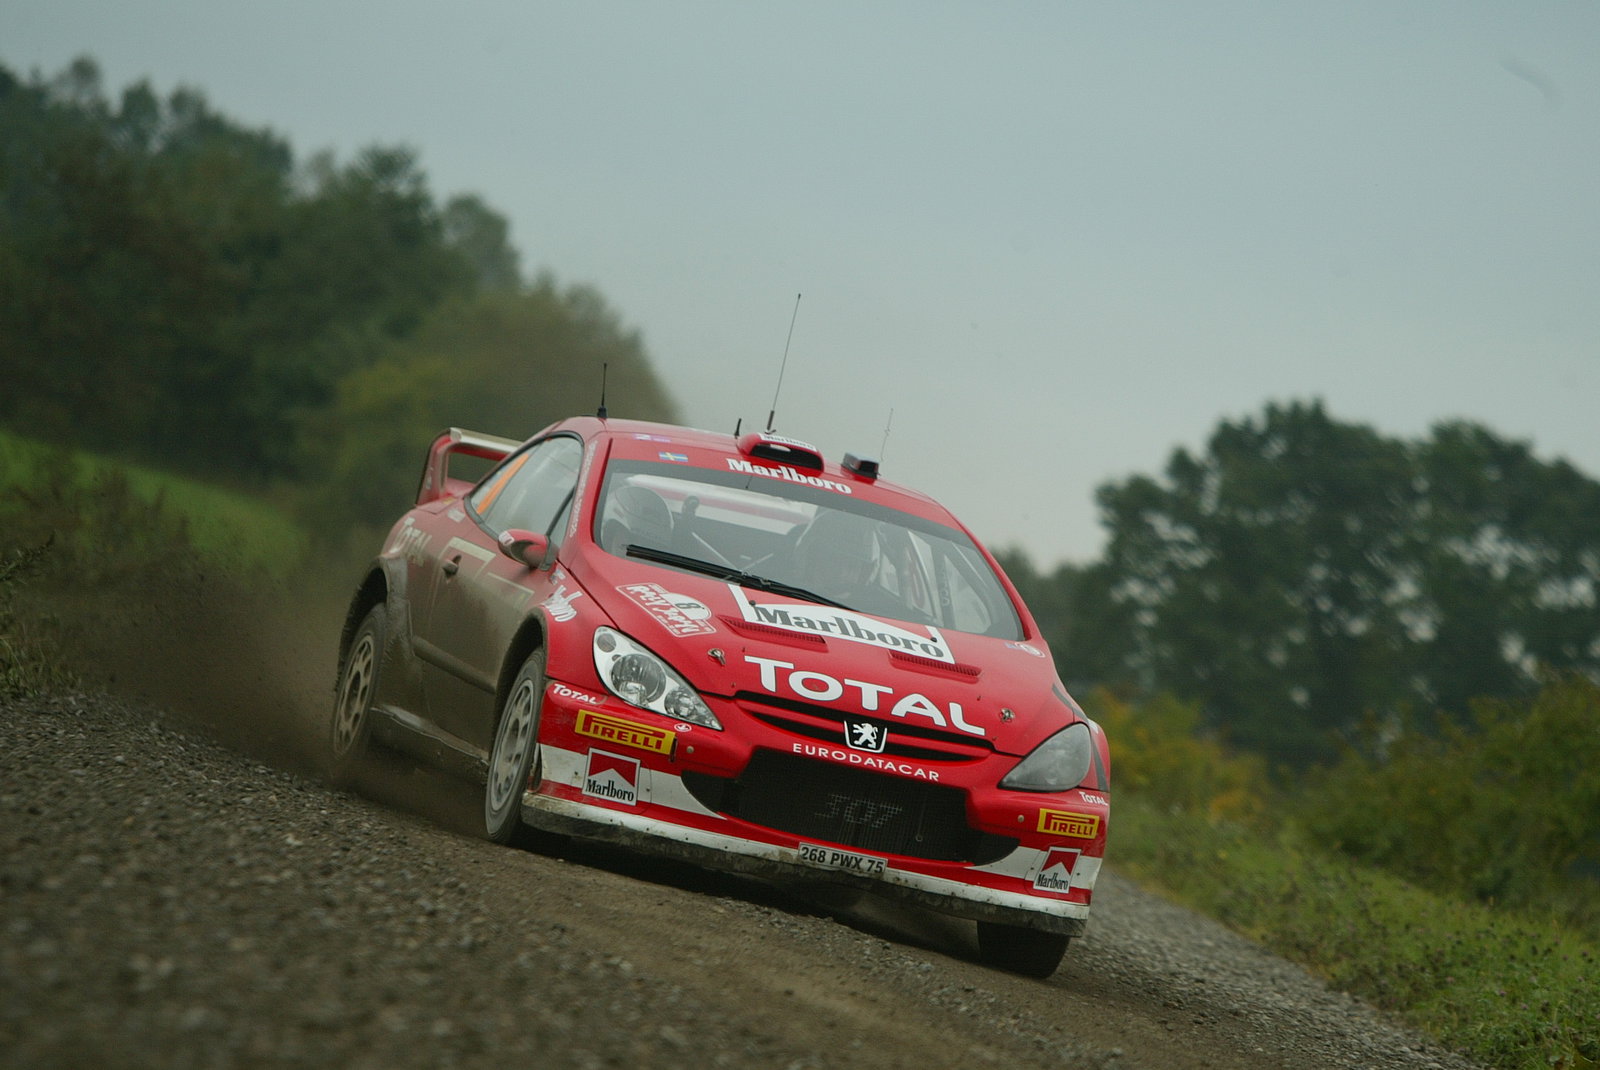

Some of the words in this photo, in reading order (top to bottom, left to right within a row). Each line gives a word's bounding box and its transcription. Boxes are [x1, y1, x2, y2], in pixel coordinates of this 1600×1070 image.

[725, 458, 852, 494] Marlboro
[753, 604, 944, 658] Marlboro
[552, 683, 598, 705] TOTAL
[743, 655, 986, 737] TOTAL
[582, 713, 666, 750] PIRELLI
[792, 742, 940, 782] EURODATACAR
[585, 773, 635, 802] Marlboro
[1079, 791, 1108, 806] TOTAL
[1043, 812, 1096, 836] PIRELLI
[801, 847, 827, 864] 268
[829, 852, 863, 870] PWX
[866, 859, 884, 874] 75
[1036, 872, 1069, 890] Marlboro
